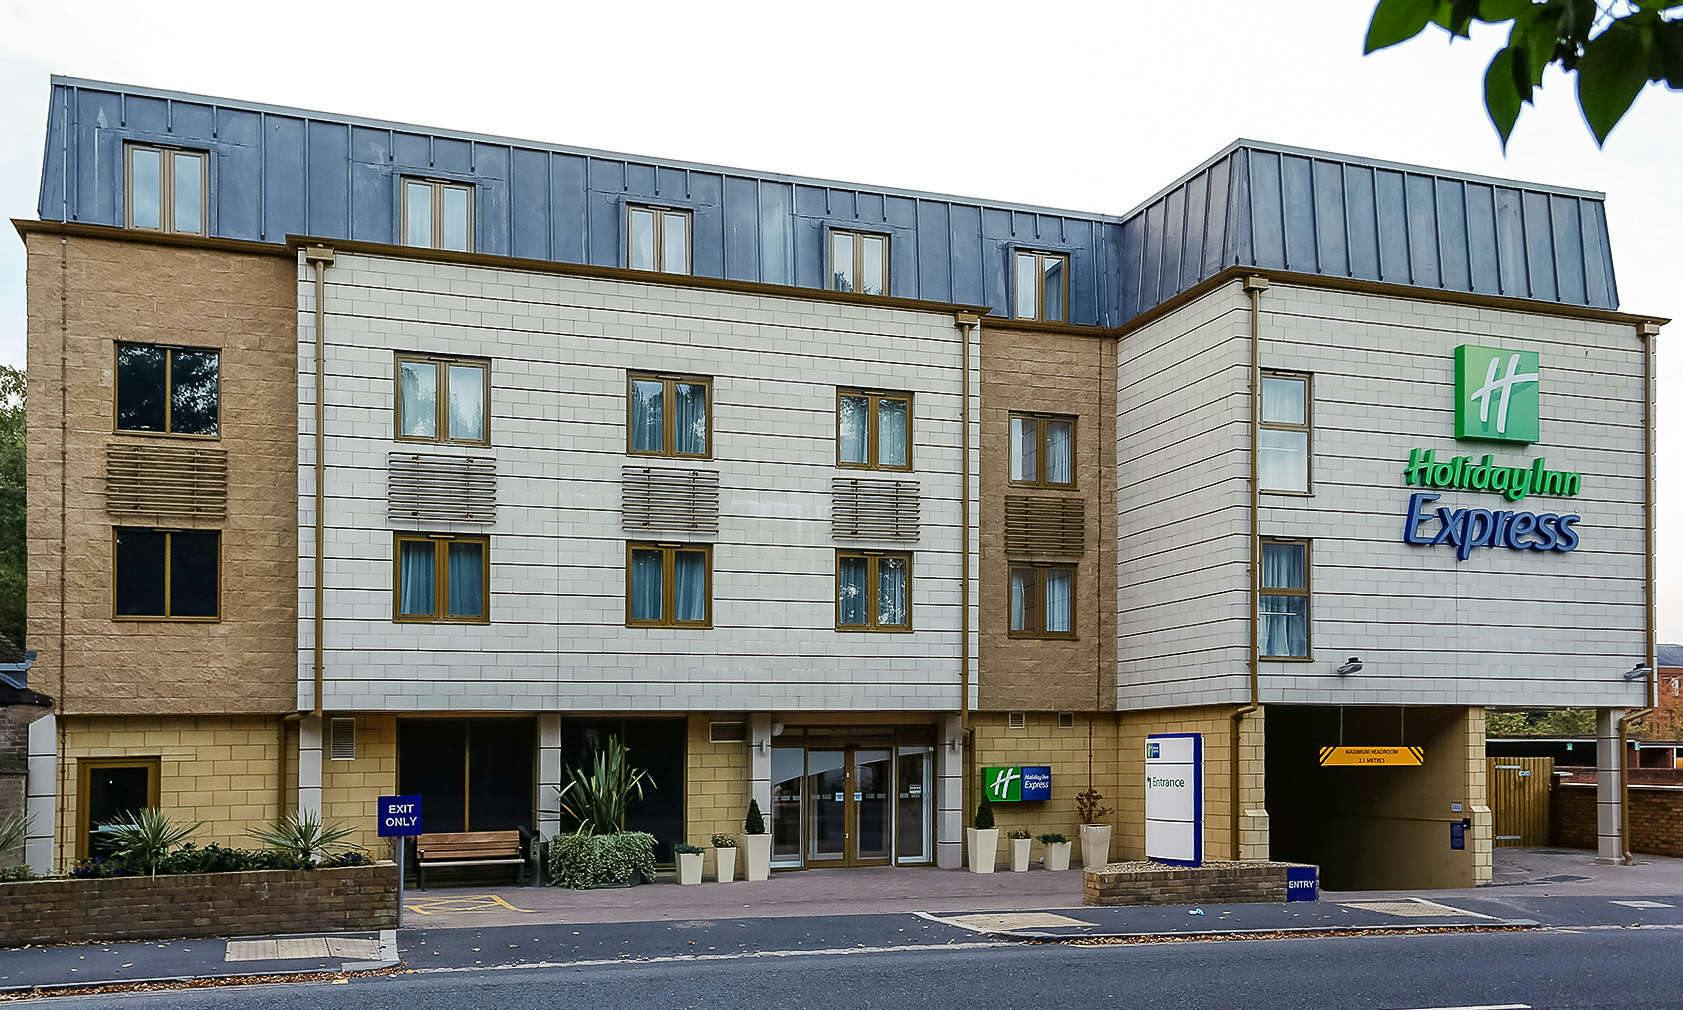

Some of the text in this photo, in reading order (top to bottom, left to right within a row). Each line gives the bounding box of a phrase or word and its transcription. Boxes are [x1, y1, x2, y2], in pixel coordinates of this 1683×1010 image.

[1404, 447, 1582, 501] Holiday Inn
[1403, 493, 1582, 561] Express
[1024, 780, 1049, 790] Express
[1152, 776, 1185, 788] Entrance
[388, 803, 415, 814] EXIT
[385, 816, 418, 827] ONLY
[1288, 880, 1314, 889] ENTRY
